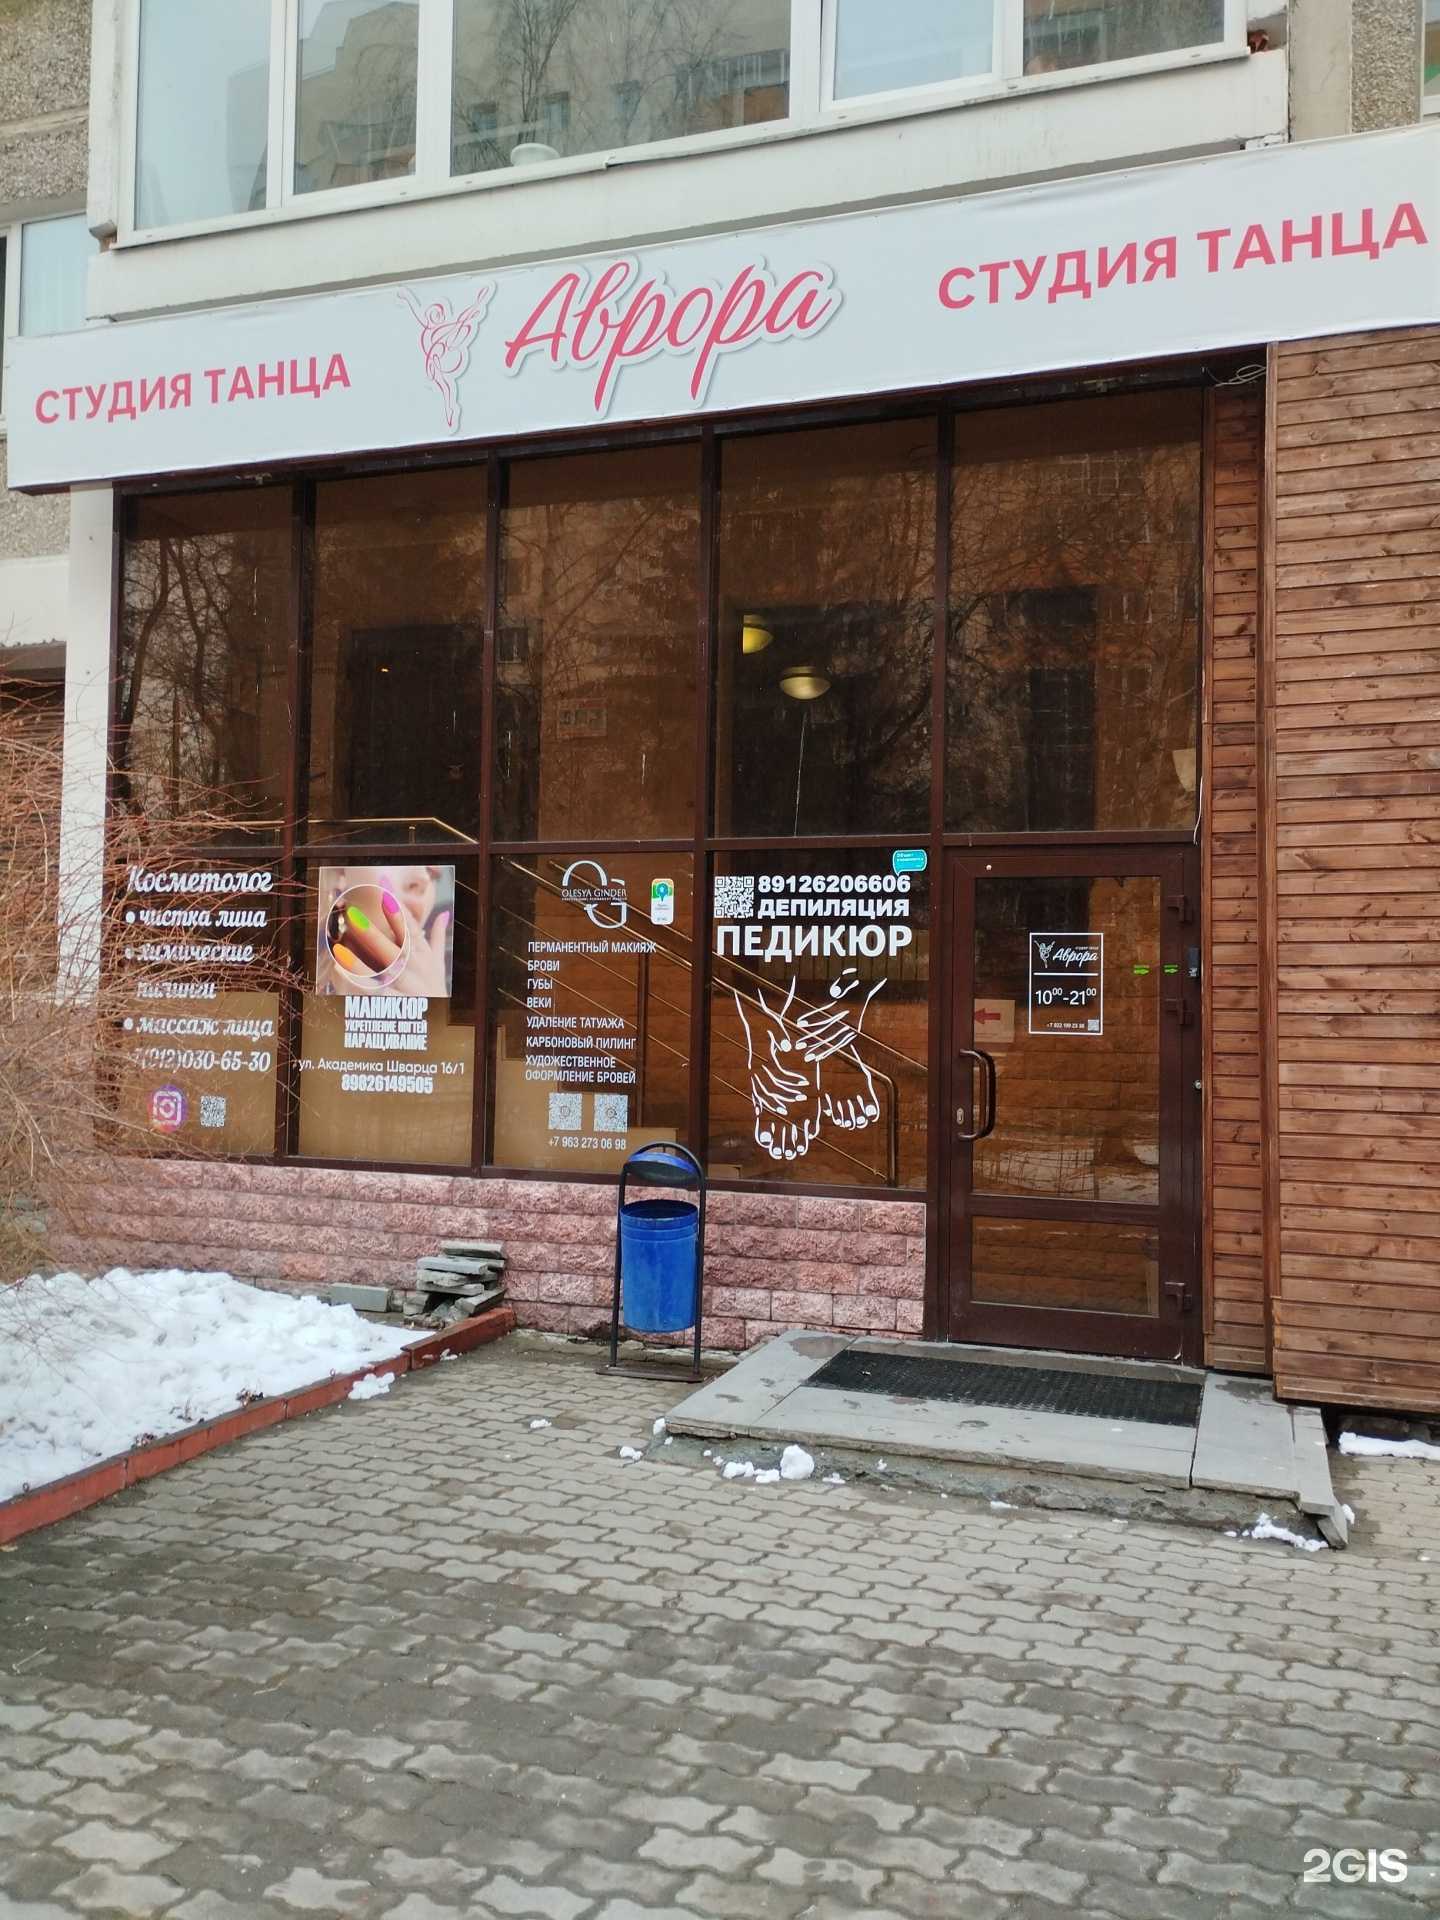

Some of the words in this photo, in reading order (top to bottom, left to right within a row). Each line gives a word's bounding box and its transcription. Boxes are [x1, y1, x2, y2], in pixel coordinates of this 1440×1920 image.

[938, 236, 1177, 309] СТУДИЯ
[1196, 202, 1429, 273] ТАНЦА
[504, 262, 833, 411] Аврора
[35, 372, 192, 424] СТУДИЯ
[203, 353, 351, 404] ТАНЦА
[127, 865, 274, 893] Косметолог
[757, 875, 911, 893] 89126206606
[561, 888, 592, 899] OLESYA
[593, 888, 627, 899] GINDER
[757, 899, 910, 919] ДЕПИЛЯЦИЯ
[139, 909, 212, 928] чистка
[528, 940, 609, 953] ПЕРМАНЕНТНЫЙ
[611, 941, 657, 953] МАКИЯЖ
[717, 925, 913, 963] ПЕДИКЮР
[527, 960, 560, 972] БРОВИ
[1052, 948, 1099, 967] Аврора
[527, 978, 553, 990] ГУБЫ
[345, 996, 428, 1019] МАНИКЮР
[526, 997, 552, 1008] ВЕКИ
[136, 1017, 219, 1037] массаж
[223, 1019, 275, 1042] лица
[345, 1019, 397, 1033] УКРЕПЛЕНИЕ
[526, 1016, 577, 1029] УДАЛЕНИЕ
[579, 1017, 625, 1029] ТАТУАЖА
[344, 1033, 427, 1051] НАРАЩИВАНИЕ
[526, 1035, 593, 1048] КАРБОНОВЫЙ
[596, 1038, 636, 1050] ПИЛИНГ
[299, 1059, 315, 1072] ул.
[317, 1057, 383, 1073] Академика
[386, 1060, 438, 1075] Шварца
[441, 1062, 465, 1075] 16/1
[525, 1055, 616, 1068] ХУДОЖЕСТВЕННОЕ
[525, 1070, 594, 1082] ОФОРМЛЕНИЕ
[597, 1071, 636, 1083] БРОВЕЙ
[549, 1136, 559, 1146] +7
[562, 1136, 579, 1148] 963
[581, 1137, 598, 1149] 273
[615, 1139, 626, 1150] 98
